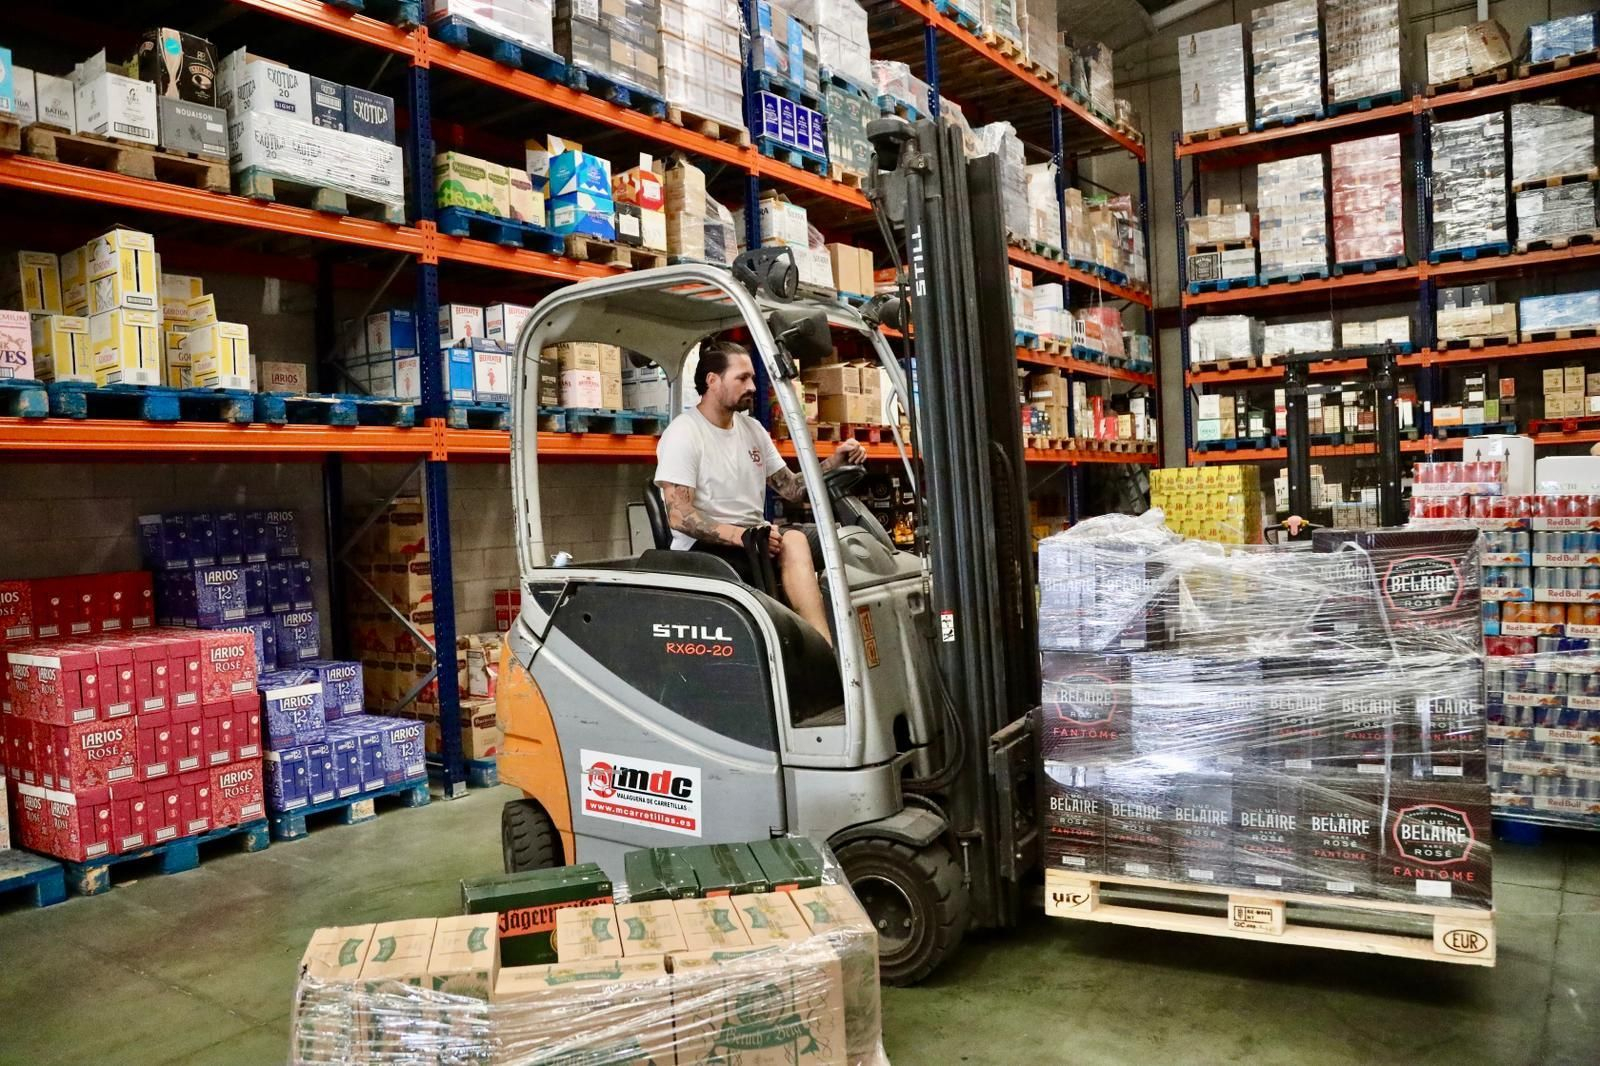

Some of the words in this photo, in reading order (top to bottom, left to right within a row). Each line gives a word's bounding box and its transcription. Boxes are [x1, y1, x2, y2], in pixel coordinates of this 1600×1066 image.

[267, 67, 299, 89] EXOTICA
[278, 89, 290, 98] 20
[45, 107, 69, 118] BATIDA
[353, 100, 388, 125] EXOTICA
[265, 150, 277, 160] 20
[911, 224, 927, 297] STILL
[271, 373, 298, 386] LARIOS
[1546, 518, 1563, 526] Red
[1563, 518, 1581, 526] Bull
[1546, 554, 1562, 562] Red
[1563, 554, 1580, 562] Bull
[204, 569, 238, 586] LARIOS
[1391, 575, 1456, 593] BELAIRE
[0, 591, 20, 603] IOS
[214, 585, 232, 601] 12
[283, 612, 313, 627] LARIOS
[294, 627, 308, 640] 12
[653, 623, 733, 641] STILL
[211, 645, 245, 662] LARIOS
[666, 642, 733, 657] RX60-20
[38, 668, 56, 684] LARIOS
[326, 665, 356, 682] LARIOS
[335, 680, 351, 695] 12
[280, 694, 314, 712] LARIOS
[1060, 690, 1111, 706] BELAIRE
[1342, 698, 1400, 714] BELAIRE
[1415, 698, 1478, 715] BELAIRE
[289, 709, 308, 724] 12
[81, 728, 123, 750] LARIOS
[390, 726, 420, 744] LARIOS
[1549, 730, 1566, 738] Red
[398, 743, 415, 757] 12
[220, 769, 254, 787] LARIOS
[619, 767, 693, 798] mdc
[51, 801, 70, 818] LARIOS
[654, 800, 688, 811] CARRETILLAS
[1050, 796, 1099, 815] BELAIRE
[1112, 803, 1163, 820] BELAIRE
[590, 802, 691, 827] www.mcarretillas.es
[1175, 806, 1228, 826] BELAIRE
[1241, 812, 1297, 831] BELAIRE
[1312, 816, 1370, 836] BELAIRE
[1401, 823, 1467, 845] BELAIRE
[1414, 848, 1453, 858] ROSÉ
[1452, 932, 1479, 950] EUR
